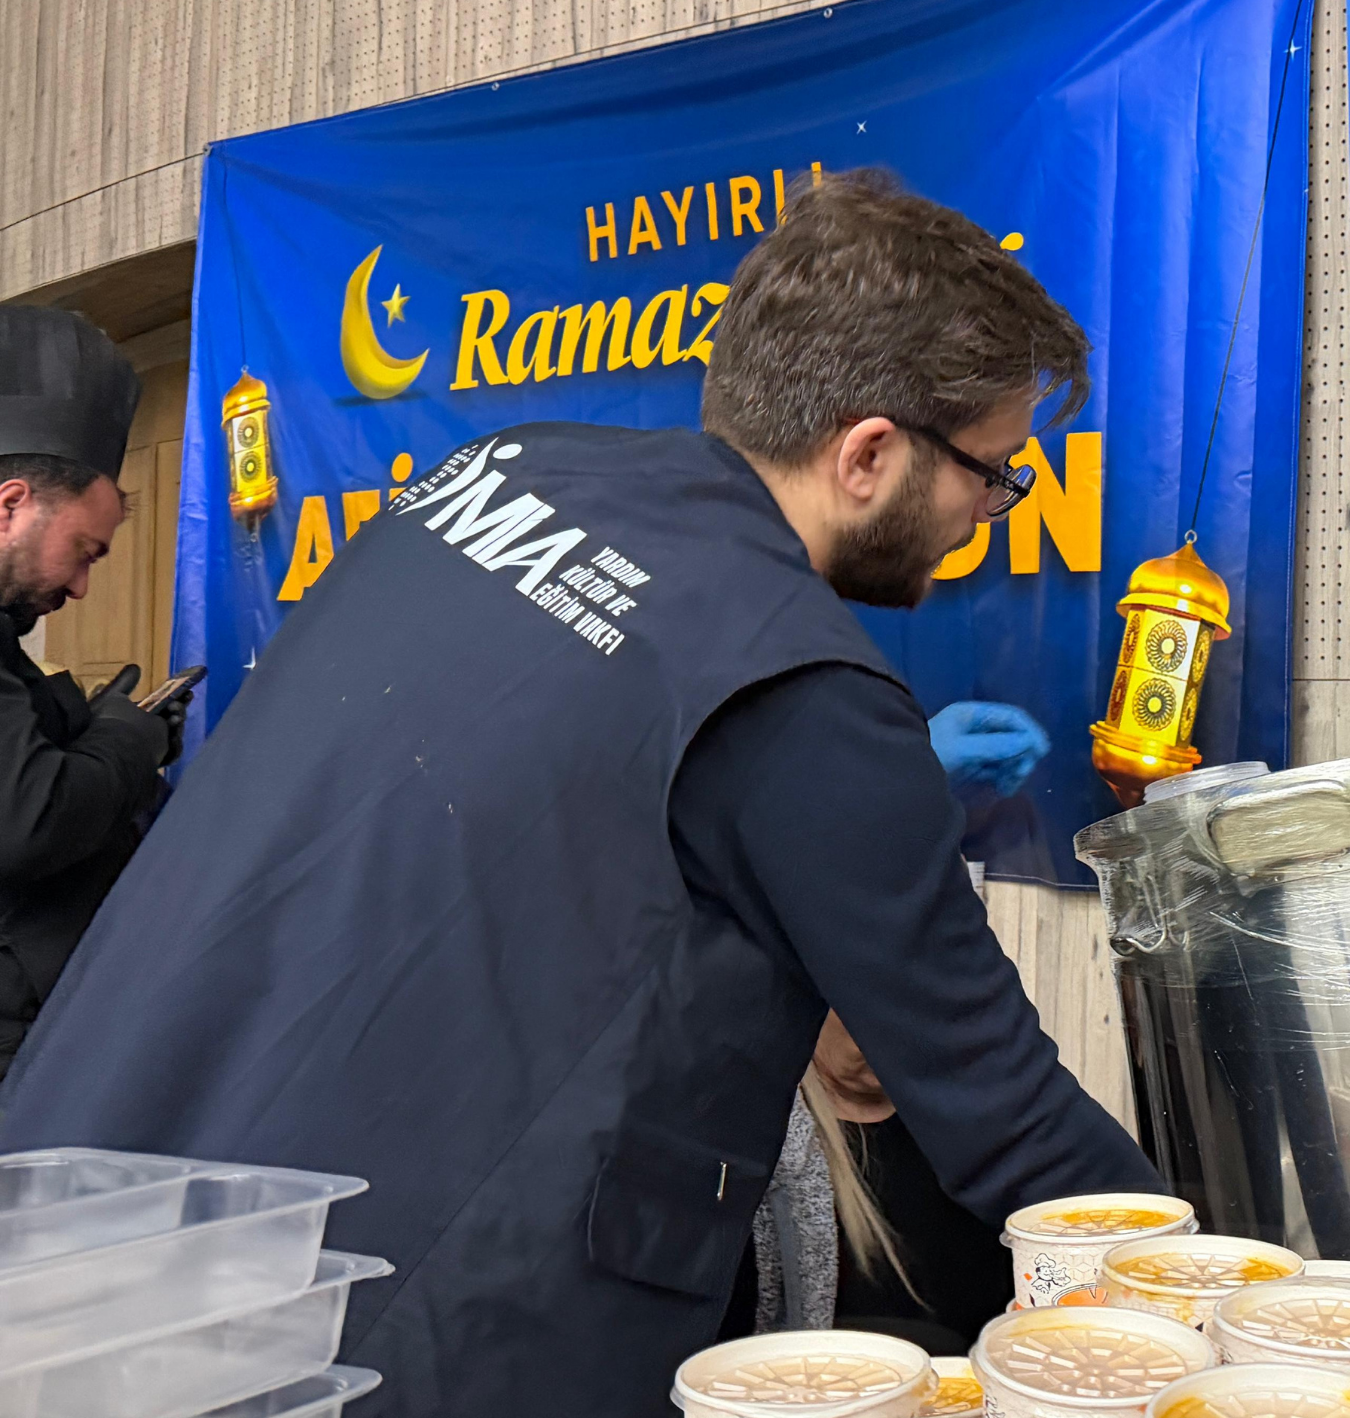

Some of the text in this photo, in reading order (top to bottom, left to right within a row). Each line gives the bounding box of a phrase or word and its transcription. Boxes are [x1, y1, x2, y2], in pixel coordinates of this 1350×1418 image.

[449, 282, 731, 391] Ramaz
[558, 564, 638, 617] KÜLTÜR VE
[590, 546, 652, 588] YARDIM
[528, 582, 626, 656] EĞİTİM VAKFI
